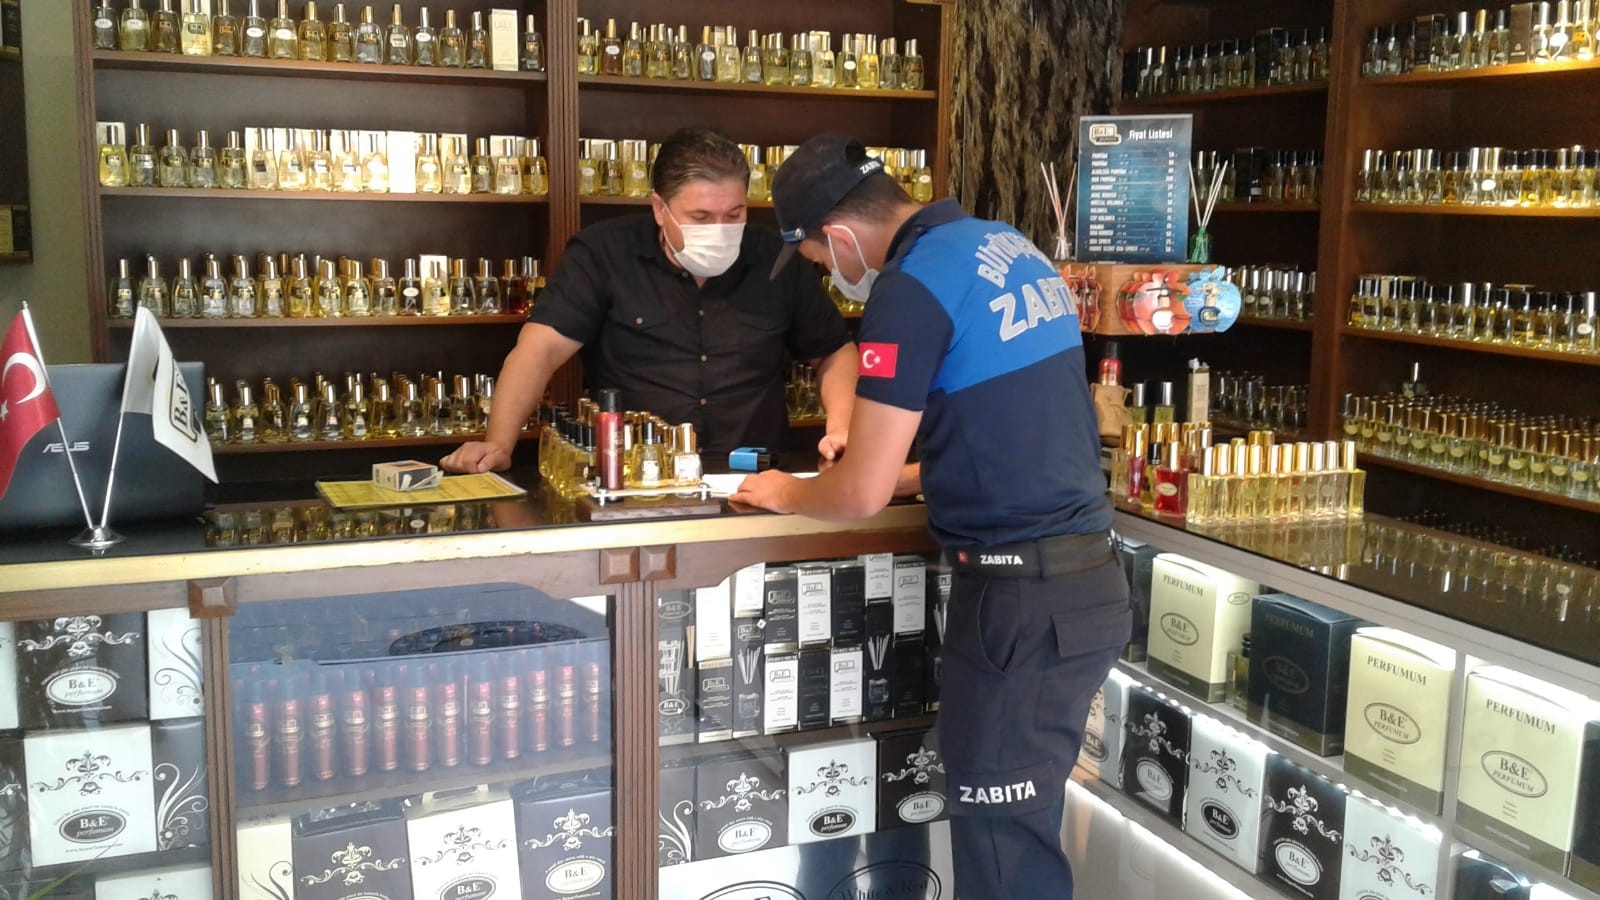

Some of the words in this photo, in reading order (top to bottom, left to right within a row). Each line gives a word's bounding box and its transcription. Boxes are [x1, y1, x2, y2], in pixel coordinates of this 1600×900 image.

[1149, 127, 1174, 139] Listesi
[43, 441, 90, 454] ASUS
[980, 554, 1024, 566] ZABITA
[1163, 574, 1204, 597] PERFUMUM
[1367, 655, 1427, 686] PERFUMUM
[1379, 709, 1406, 729] B&E
[1486, 698, 1556, 735] PERFUMUM
[1374, 721, 1409, 740] PERFUMUM
[1499, 757, 1529, 781] B&E
[1492, 770, 1534, 793] PERFUMUM
[959, 780, 1037, 804] ZABITA
[80, 816, 109, 829] B&E
[456, 881, 481, 895] B&E
